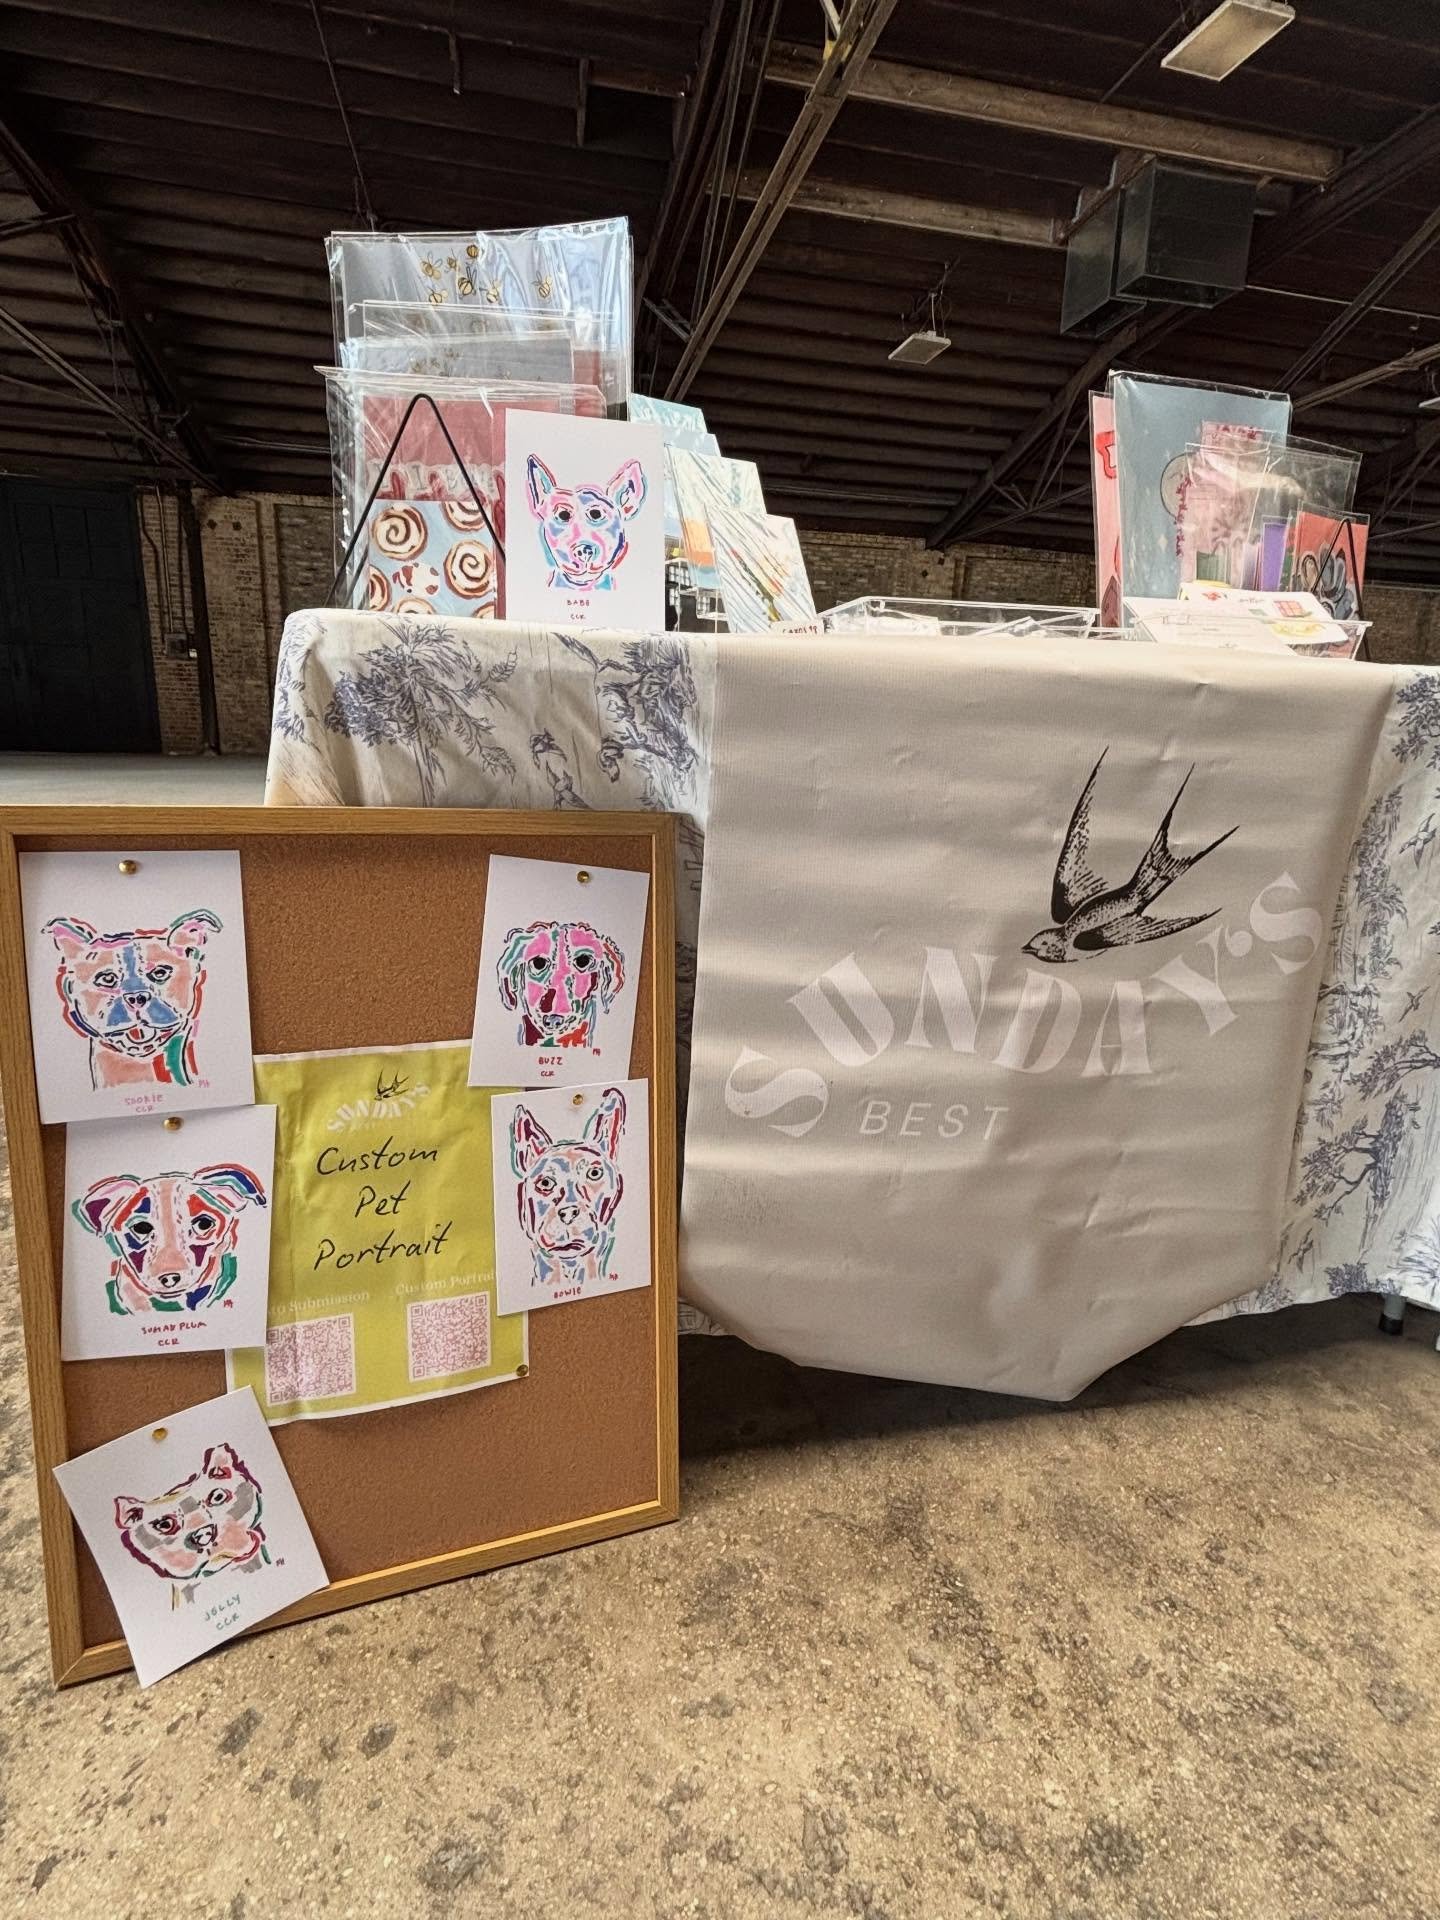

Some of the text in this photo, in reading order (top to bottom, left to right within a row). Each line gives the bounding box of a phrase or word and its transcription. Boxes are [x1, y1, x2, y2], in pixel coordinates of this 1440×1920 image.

[724, 870, 1323, 1138] SUNDAY'S
[538, 1056, 563, 1065] BUZZ
[858, 1099, 1010, 1141] BEST
[316, 1135, 440, 1176] Custom
[354, 1180, 412, 1218] Pet
[313, 1221, 453, 1272] Portrait
[450, 1271, 497, 1287] Portrai
[553, 1286, 582, 1299] BOWIE
[204, 1593, 241, 1621] JOLLY
